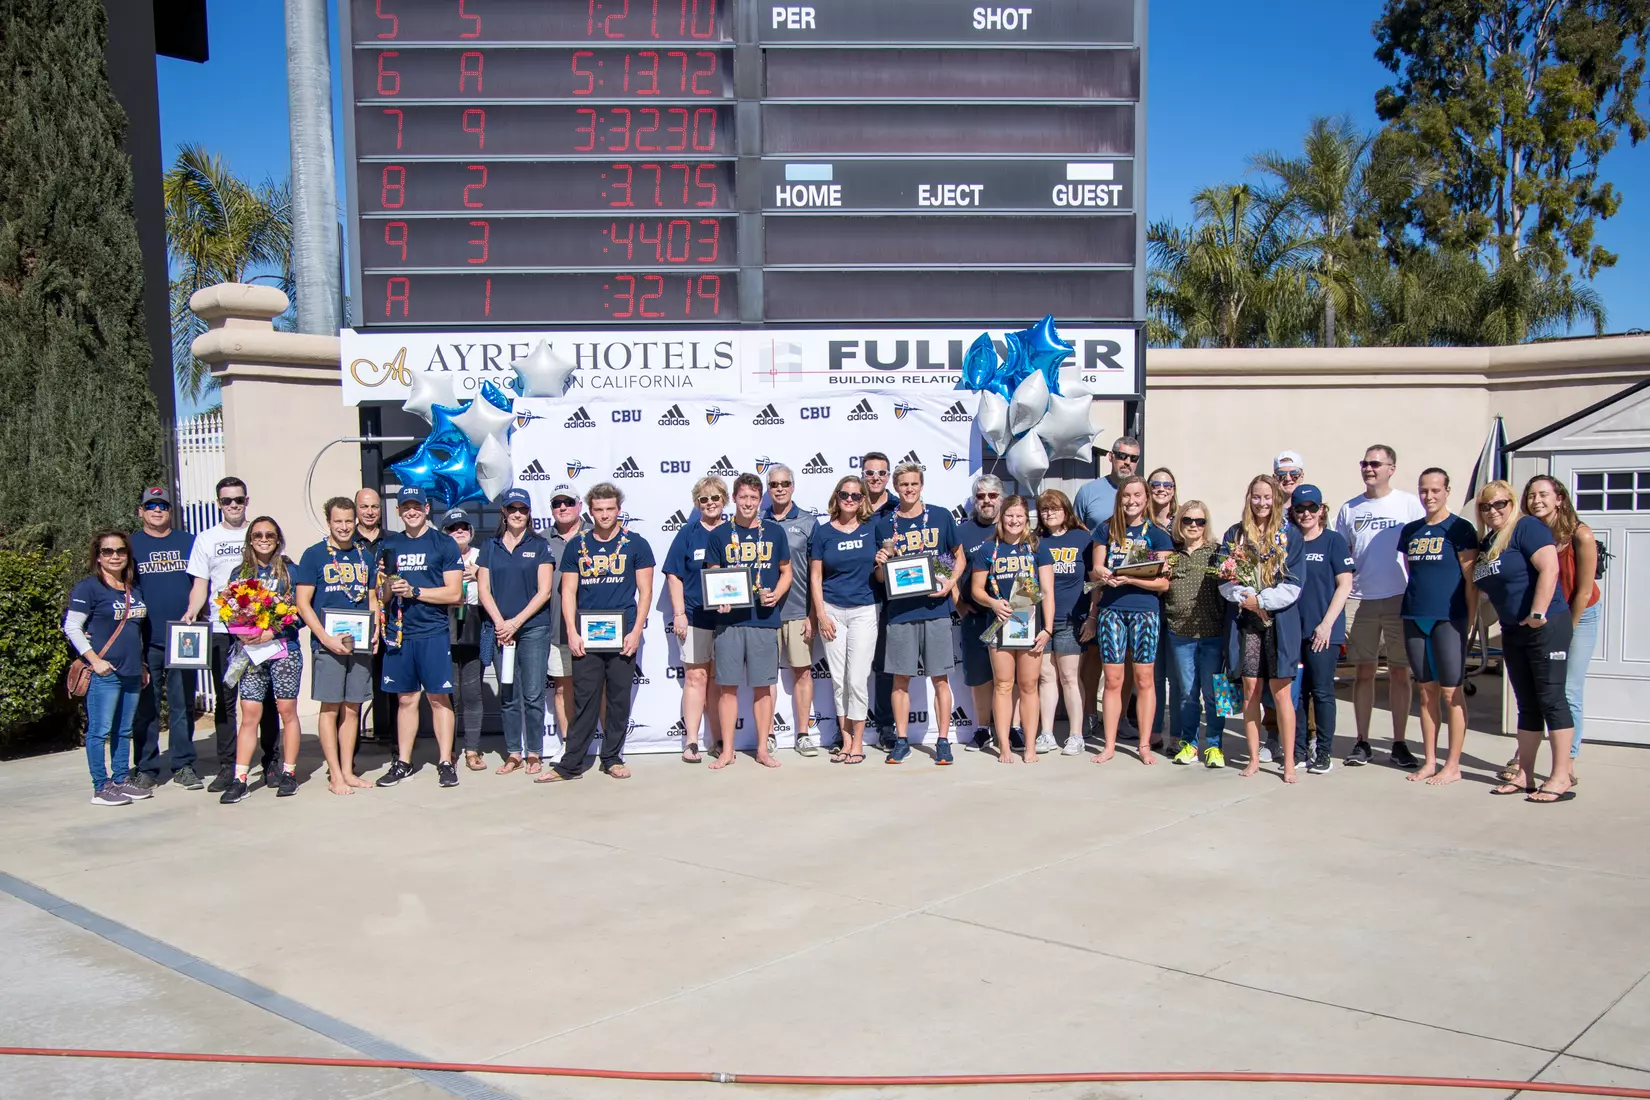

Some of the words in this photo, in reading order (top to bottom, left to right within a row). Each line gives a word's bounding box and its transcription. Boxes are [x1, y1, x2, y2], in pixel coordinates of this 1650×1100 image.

[772, 7, 816, 30] PER
[972, 7, 1033, 30] SHOT
[377, 51, 400, 95] 6
[459, 51, 484, 93] A
[382, 109, 403, 149] 7
[462, 109, 486, 149] 9
[381, 165, 406, 208] 8
[463, 165, 488, 207] 2
[775, 184, 842, 207] HOME
[917, 184, 984, 206] EJECT
[1052, 184, 1123, 207] GUEST
[384, 221, 408, 261] 9
[467, 220, 490, 263] 3
[385, 277, 410, 316] A
[424, 342, 553, 372] AYRE
[572, 340, 734, 371] HOTELS
[590, 375, 694, 389] CALIFORNIA
[829, 375, 896, 384] BUILDING
[902, 375, 962, 384] RELATIO
[611, 409, 642, 423] CBU
[800, 406, 831, 420] CBU
[847, 412, 879, 421] adidas
[941, 413, 973, 422] adidas
[563, 420, 596, 429] adidas
[657, 417, 690, 426] adidas
[752, 416, 785, 426] adidas
[660, 460, 691, 473] CBU
[801, 465, 834, 475] adidas
[518, 472, 551, 481] adidas
[612, 470, 645, 479] adidas
[403, 487, 419, 495] CBU
[554, 484, 570, 492] CBU
[1370, 519, 1397, 530] CBU
[837, 539, 863, 551] CBU
[1408, 537, 1445, 555] CBU
[149, 550, 181, 563] CBU
[397, 553, 427, 566] CBU
[725, 541, 774, 564] CBU
[137, 560, 188, 575] SWIMMIN
[578, 554, 628, 577] CBU
[995, 555, 1032, 574] CBU
[323, 562, 369, 584] CBU
